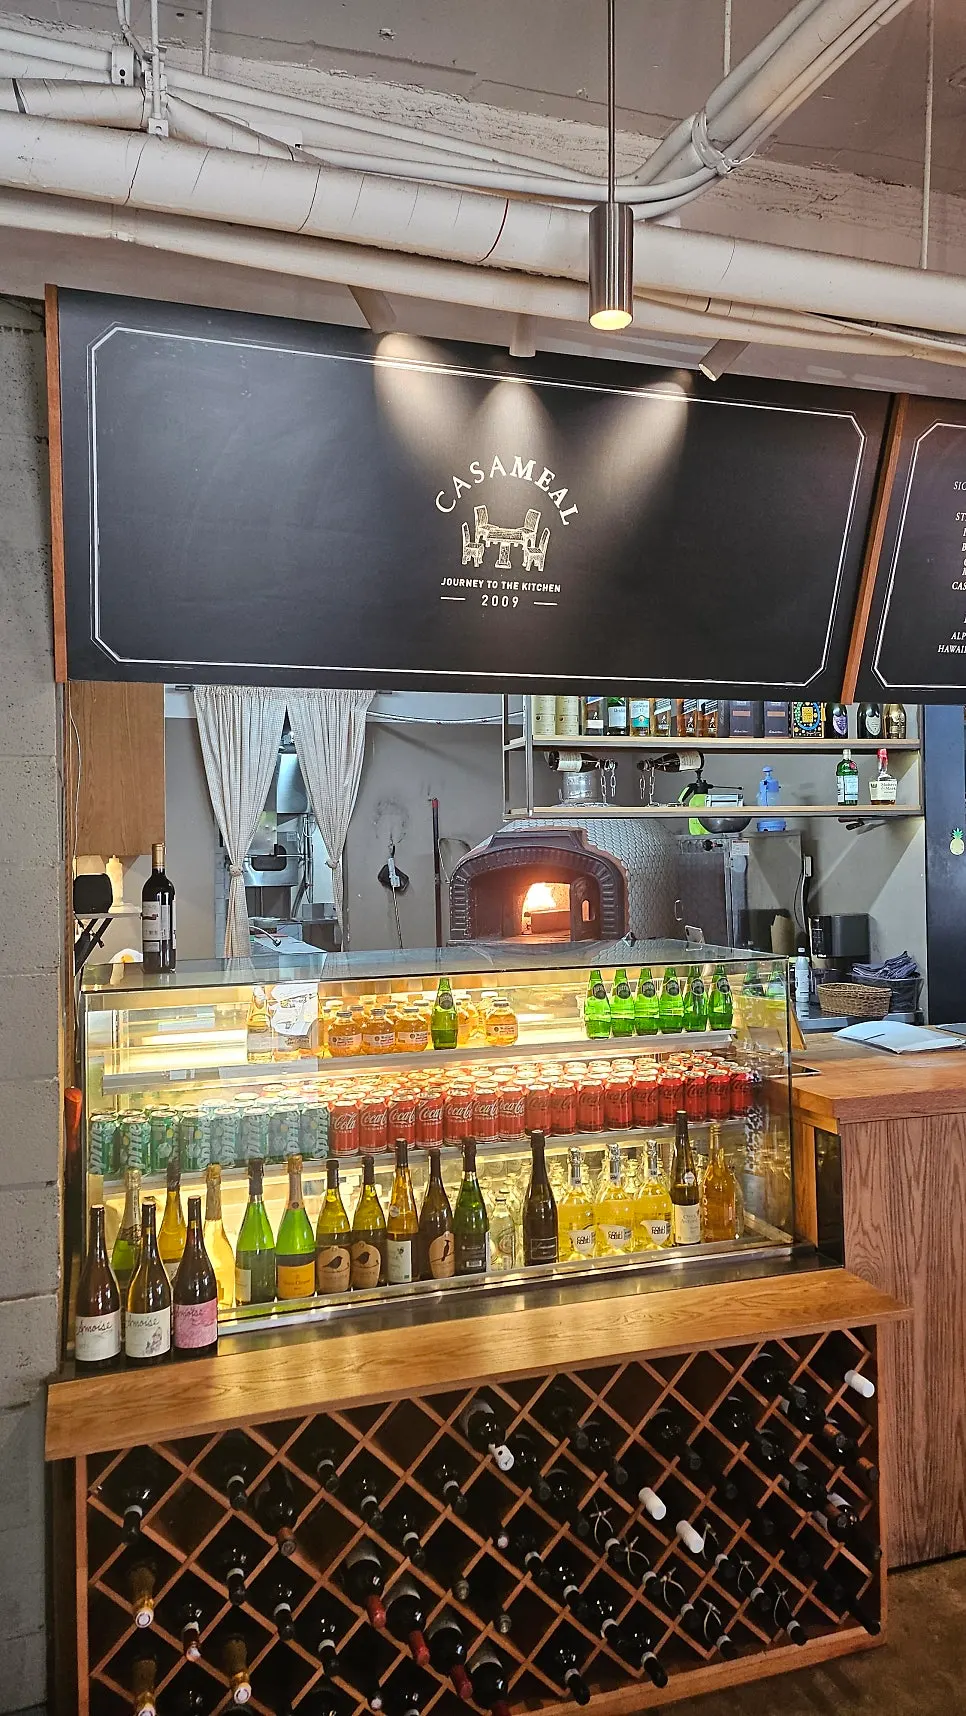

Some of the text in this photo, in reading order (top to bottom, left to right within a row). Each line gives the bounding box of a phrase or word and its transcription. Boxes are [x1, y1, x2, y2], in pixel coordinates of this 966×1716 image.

[435, 455, 579, 525] CASAMEAL
[440, 577, 561, 593] JOURNEY TO THE KITCHEN
[951, 581, 966, 591] CAS
[481, 594, 519, 608] 2009
[951, 631, 966, 641] ALP
